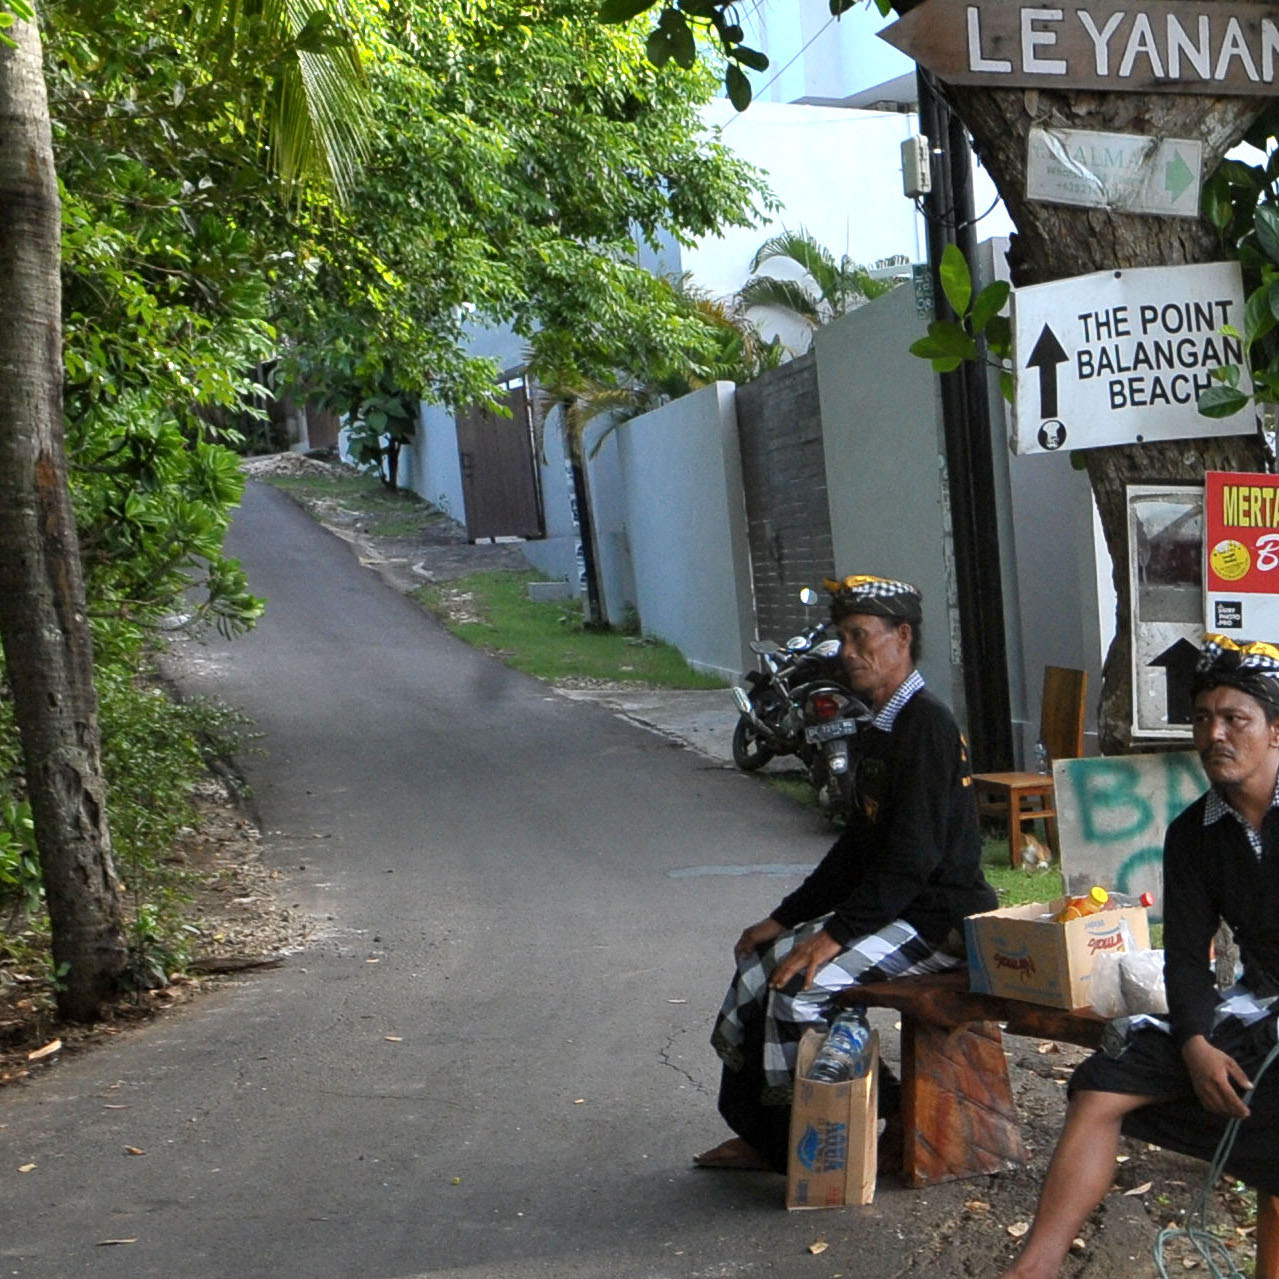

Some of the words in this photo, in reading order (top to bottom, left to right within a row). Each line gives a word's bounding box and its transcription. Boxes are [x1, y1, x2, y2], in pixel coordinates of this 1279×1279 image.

[1078, 305, 1131, 343] THE
[1140, 300, 1233, 335] POINT
[1077, 335, 1244, 380] BALANGAN
[1108, 372, 1213, 410] BEACH
[824, 1121, 847, 1172] AQUA
